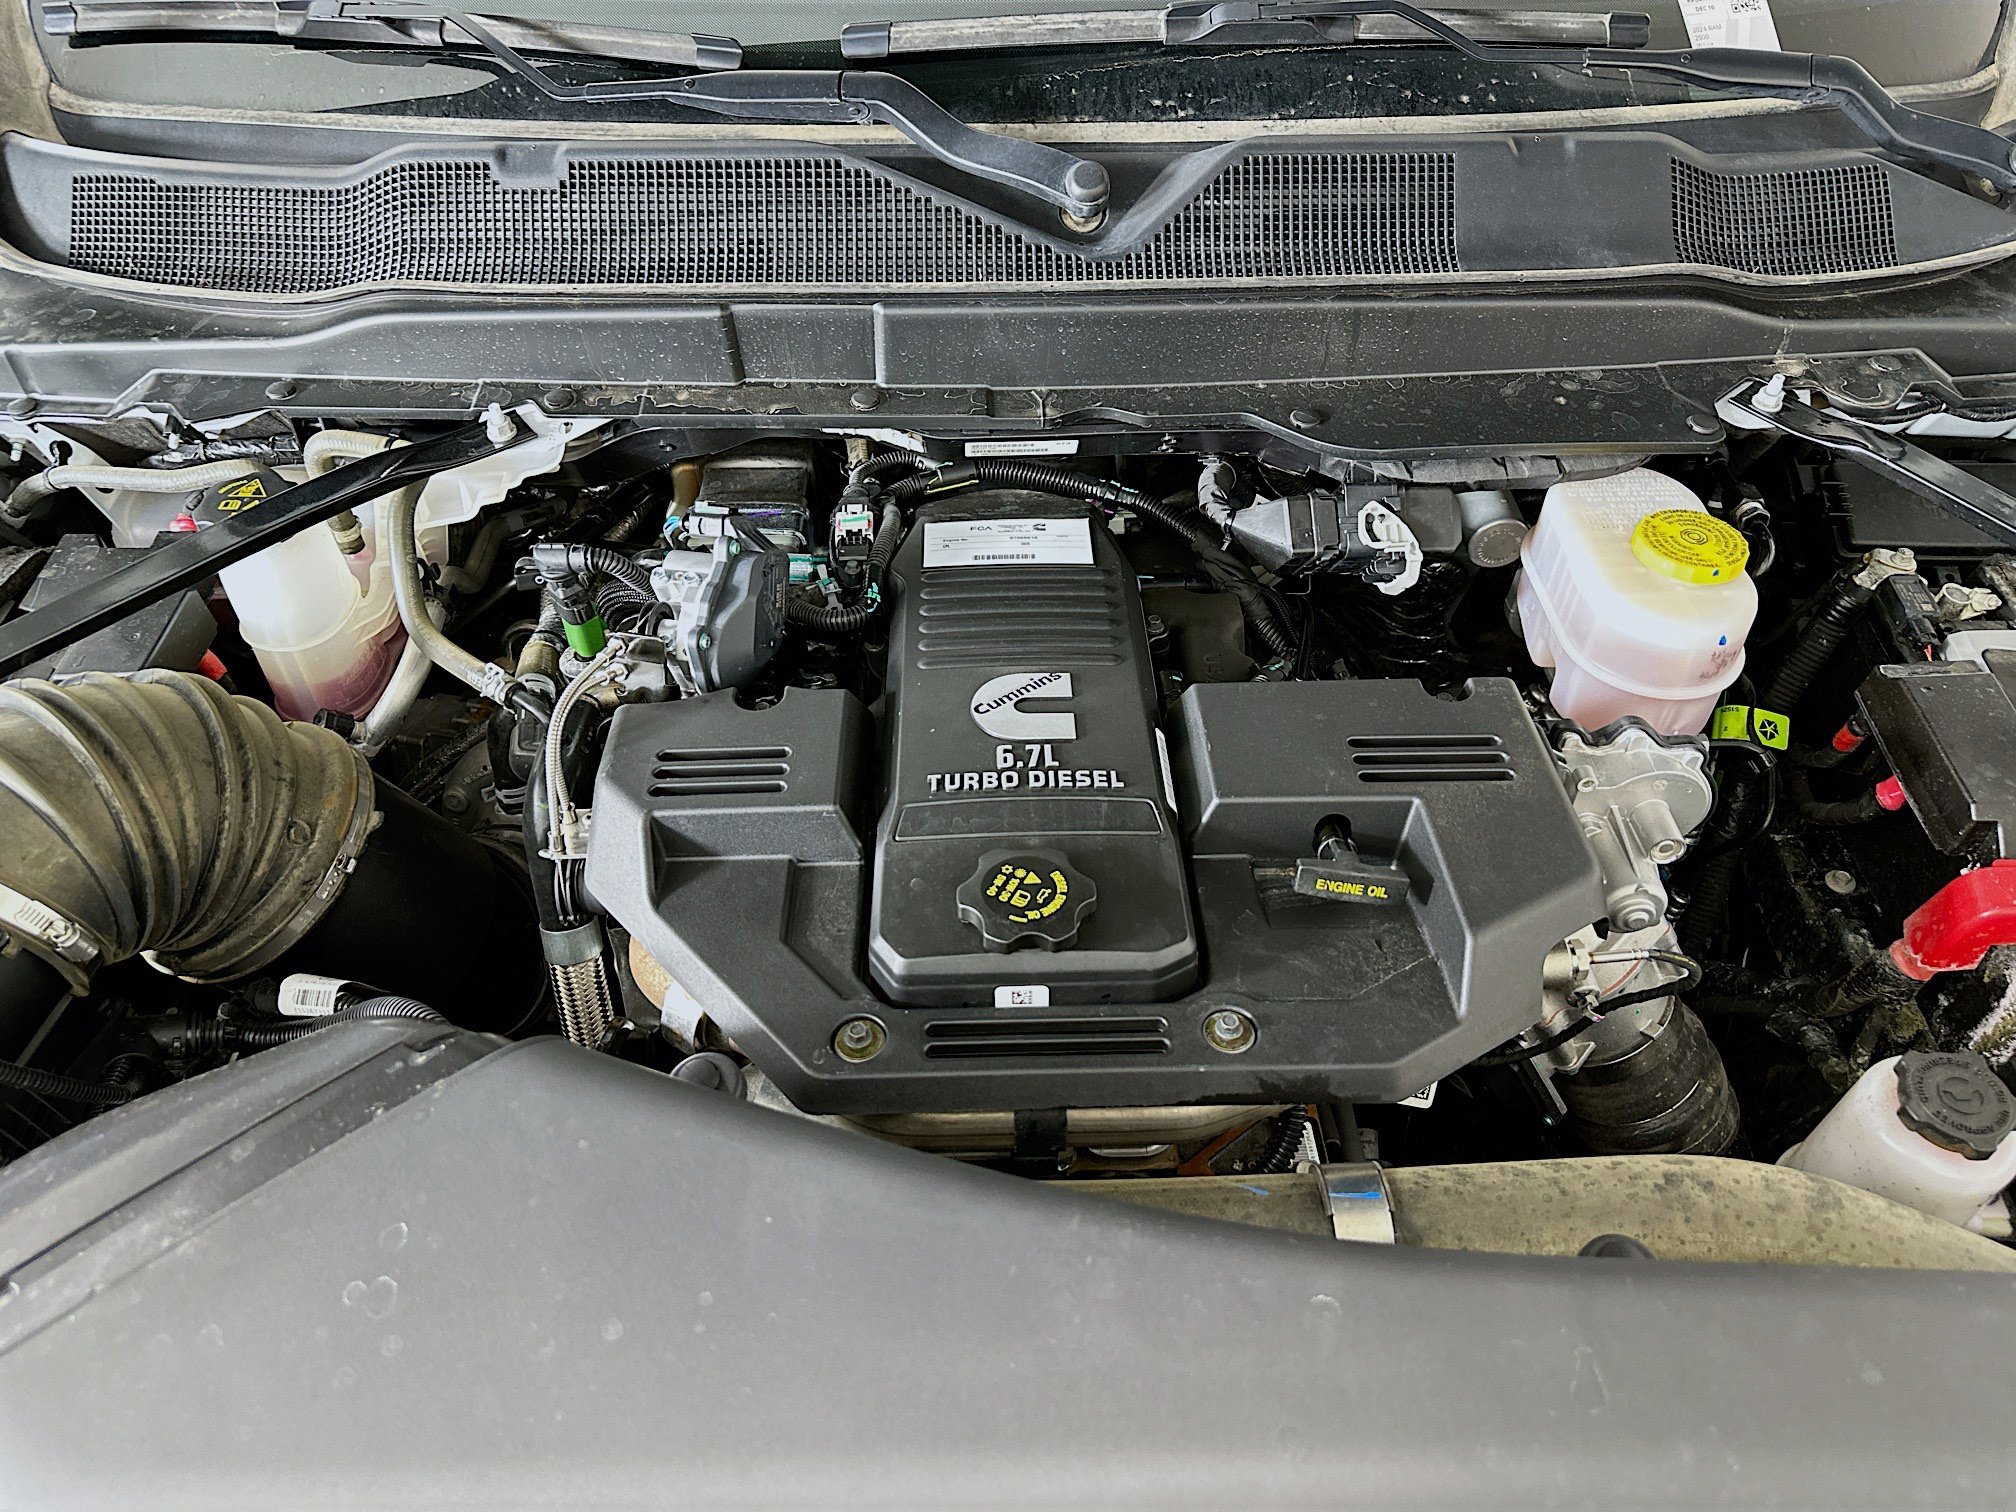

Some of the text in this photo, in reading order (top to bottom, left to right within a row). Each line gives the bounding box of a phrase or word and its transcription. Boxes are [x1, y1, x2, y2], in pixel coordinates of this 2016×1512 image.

[973, 672, 1062, 715] Cummins
[995, 744, 1060, 769] 6.7L
[927, 770, 1125, 793] TURBO DIESEL
[1315, 878, 1388, 899] ENGINE OIL
